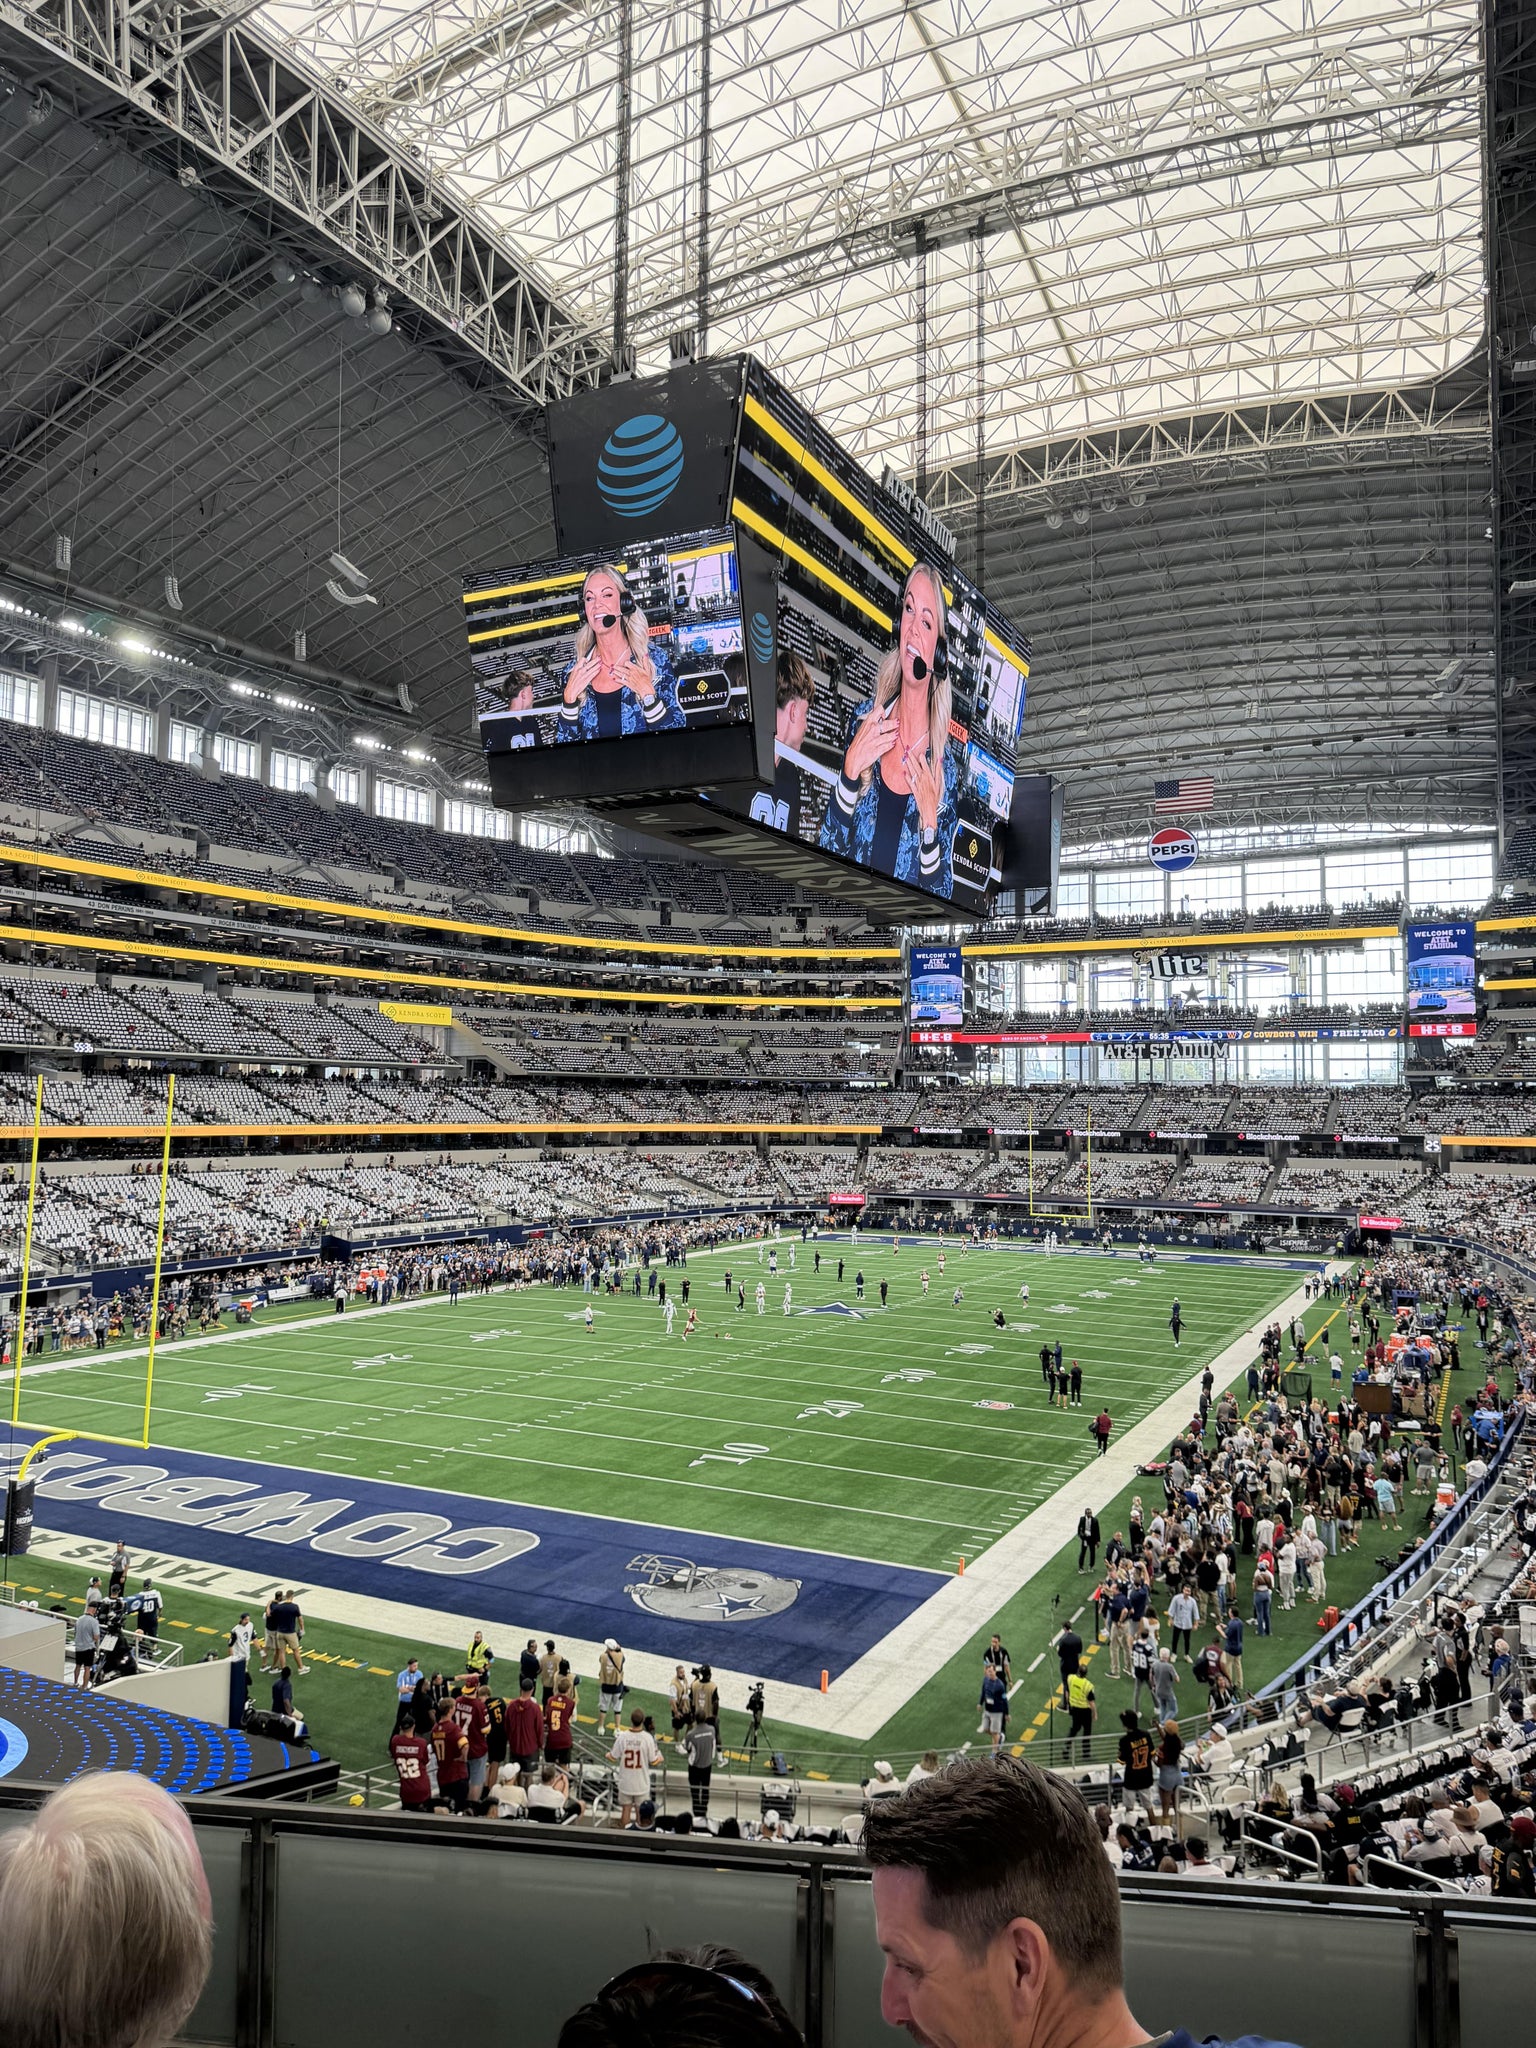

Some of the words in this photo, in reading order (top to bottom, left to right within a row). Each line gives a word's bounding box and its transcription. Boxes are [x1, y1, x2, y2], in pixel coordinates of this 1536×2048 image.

[884, 469, 914, 514] AT&T
[912, 496, 958, 560] STADIUM
[707, 691, 728, 700] SCOTT
[1152, 844, 1195, 856] PEPSI
[954, 853, 972, 869] KENDRA
[973, 860, 989, 876] SCOTT
[111, 904, 134, 913] PERKINS
[1423, 942, 1458, 950] STADIUM
[1150, 955, 1202, 982] Lite
[1104, 1044, 1145, 1059] AT&T
[1150, 1043, 1229, 1059] STADIUM
[1156, 1131, 1208, 1139] Blockchain.com
[1246, 1133, 1300, 1142] Blockchain.com
[1342, 1134, 1398, 1143] Blockchain.com
[1425, 1140, 1440, 1150] 25
[884, 1368, 937, 1383] 30
[804, 1400, 865, 1418] 20
[700, 1443, 770, 1466] 10
[243, 1632, 248, 1642] 3
[1133, 1652, 1147, 1669] 88
[455, 1710, 472, 1736] 17
[494, 1708, 502, 1723] 5
[551, 1710, 561, 1731] 5
[624, 1750, 642, 1769] 21
[1132, 1745, 1148, 1769] 17
